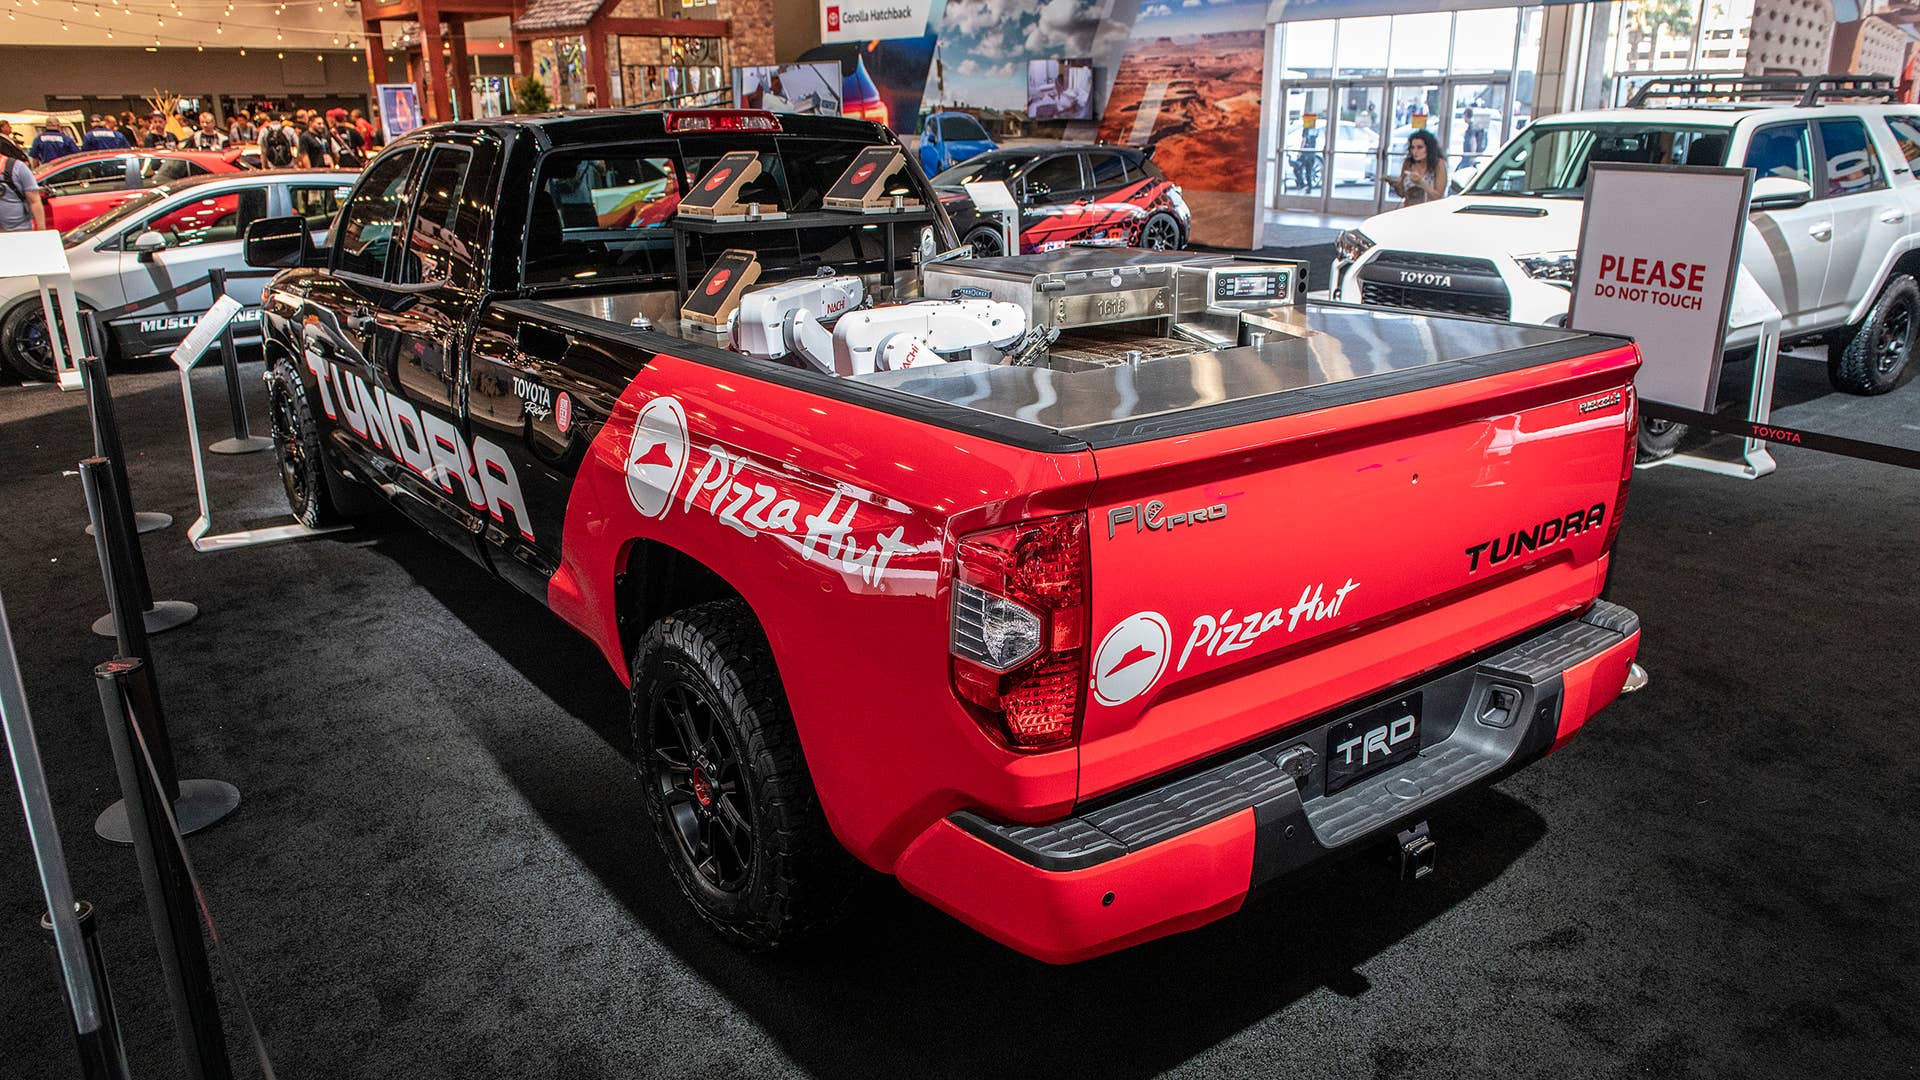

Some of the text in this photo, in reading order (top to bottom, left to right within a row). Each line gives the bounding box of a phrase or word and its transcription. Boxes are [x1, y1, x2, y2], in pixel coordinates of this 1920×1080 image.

[842, 6, 912, 24] Corolla Hatchback
[1400, 271, 1451, 287] TOYOTA
[1599, 254, 1706, 292] PLEASE
[1595, 284, 1702, 311] DO NOT TOUCH
[513, 376, 551, 408] TOYOTA
[305, 350, 536, 543] TUNDRA
[1752, 425, 1802, 443] TOYOTA
[684, 444, 919, 588] Pizza Hut
[1465, 502, 1606, 575] TUNDRA
[1177, 577, 1360, 672] Pizza Hut
[1336, 714, 1415, 766] TRD
